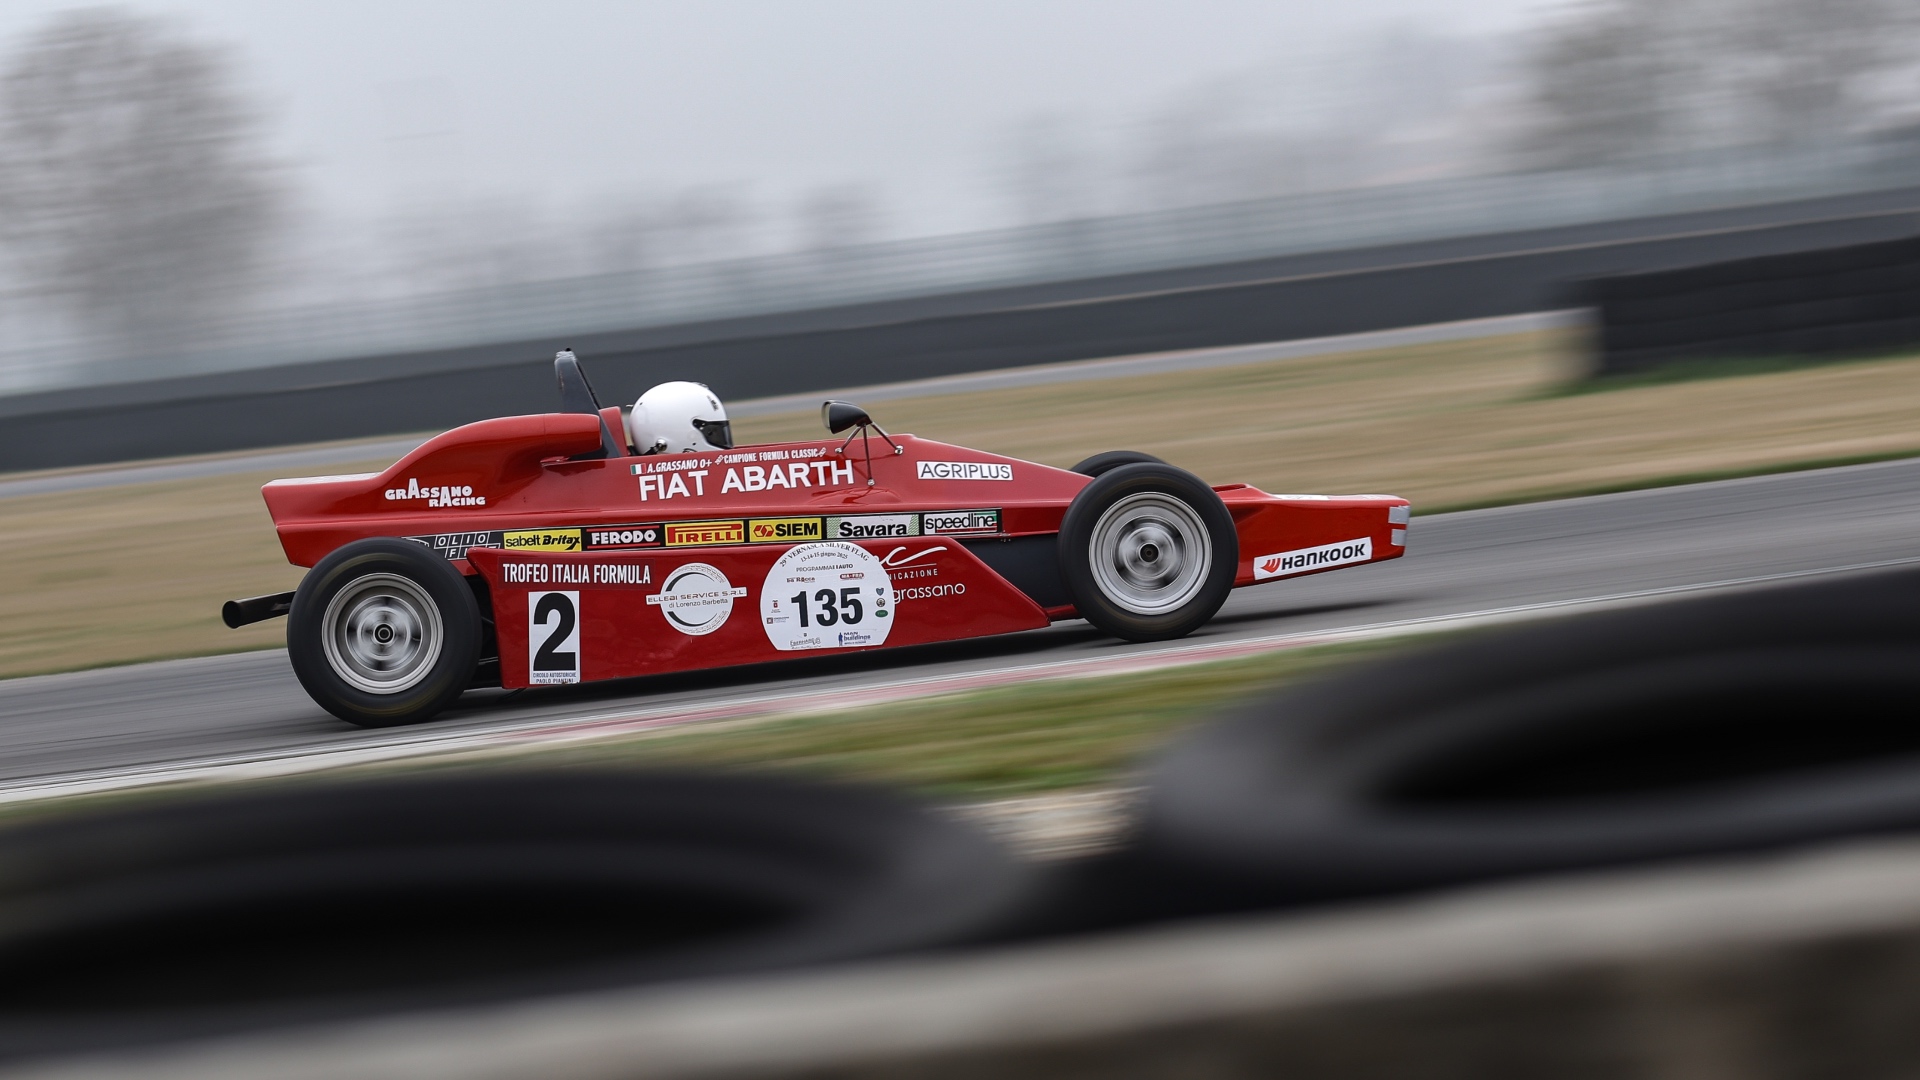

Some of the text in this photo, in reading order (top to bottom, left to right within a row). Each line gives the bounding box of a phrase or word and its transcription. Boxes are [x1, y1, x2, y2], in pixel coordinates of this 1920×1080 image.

[724, 453, 757, 464] CAMPIONE
[759, 450, 790, 461] FORMULA
[791, 448, 818, 459] CLASSIC
[647, 459, 698, 474] A.GRASSANO
[920, 463, 1010, 479] AGRIPLUS
[639, 460, 855, 501] FIAT ABARTH
[385, 478, 473, 504] GRASSANO
[429, 491, 486, 508] RACING
[775, 522, 818, 537] SIEM
[839, 521, 907, 537] Savara
[925, 512, 995, 533] speedline
[438, 533, 486, 547] OLIO
[591, 529, 657, 545] FERODO
[667, 523, 743, 544] PIRELLI
[505, 534, 581, 550] sabelt Britax
[787, 543, 824, 559] VERNASCA
[825, 542, 851, 551] SILVER
[851, 547, 870, 561] FLAG
[503, 563, 549, 583] TROFEO
[552, 564, 590, 583] ITALIA
[593, 564, 651, 584] FORMULA
[648, 589, 747, 603] ELLEBI SERVICE S.R.L.
[702, 598, 729, 606] Barbetta
[893, 583, 966, 605] grassano
[790, 587, 864, 628] 135
[533, 592, 576, 671] 2
